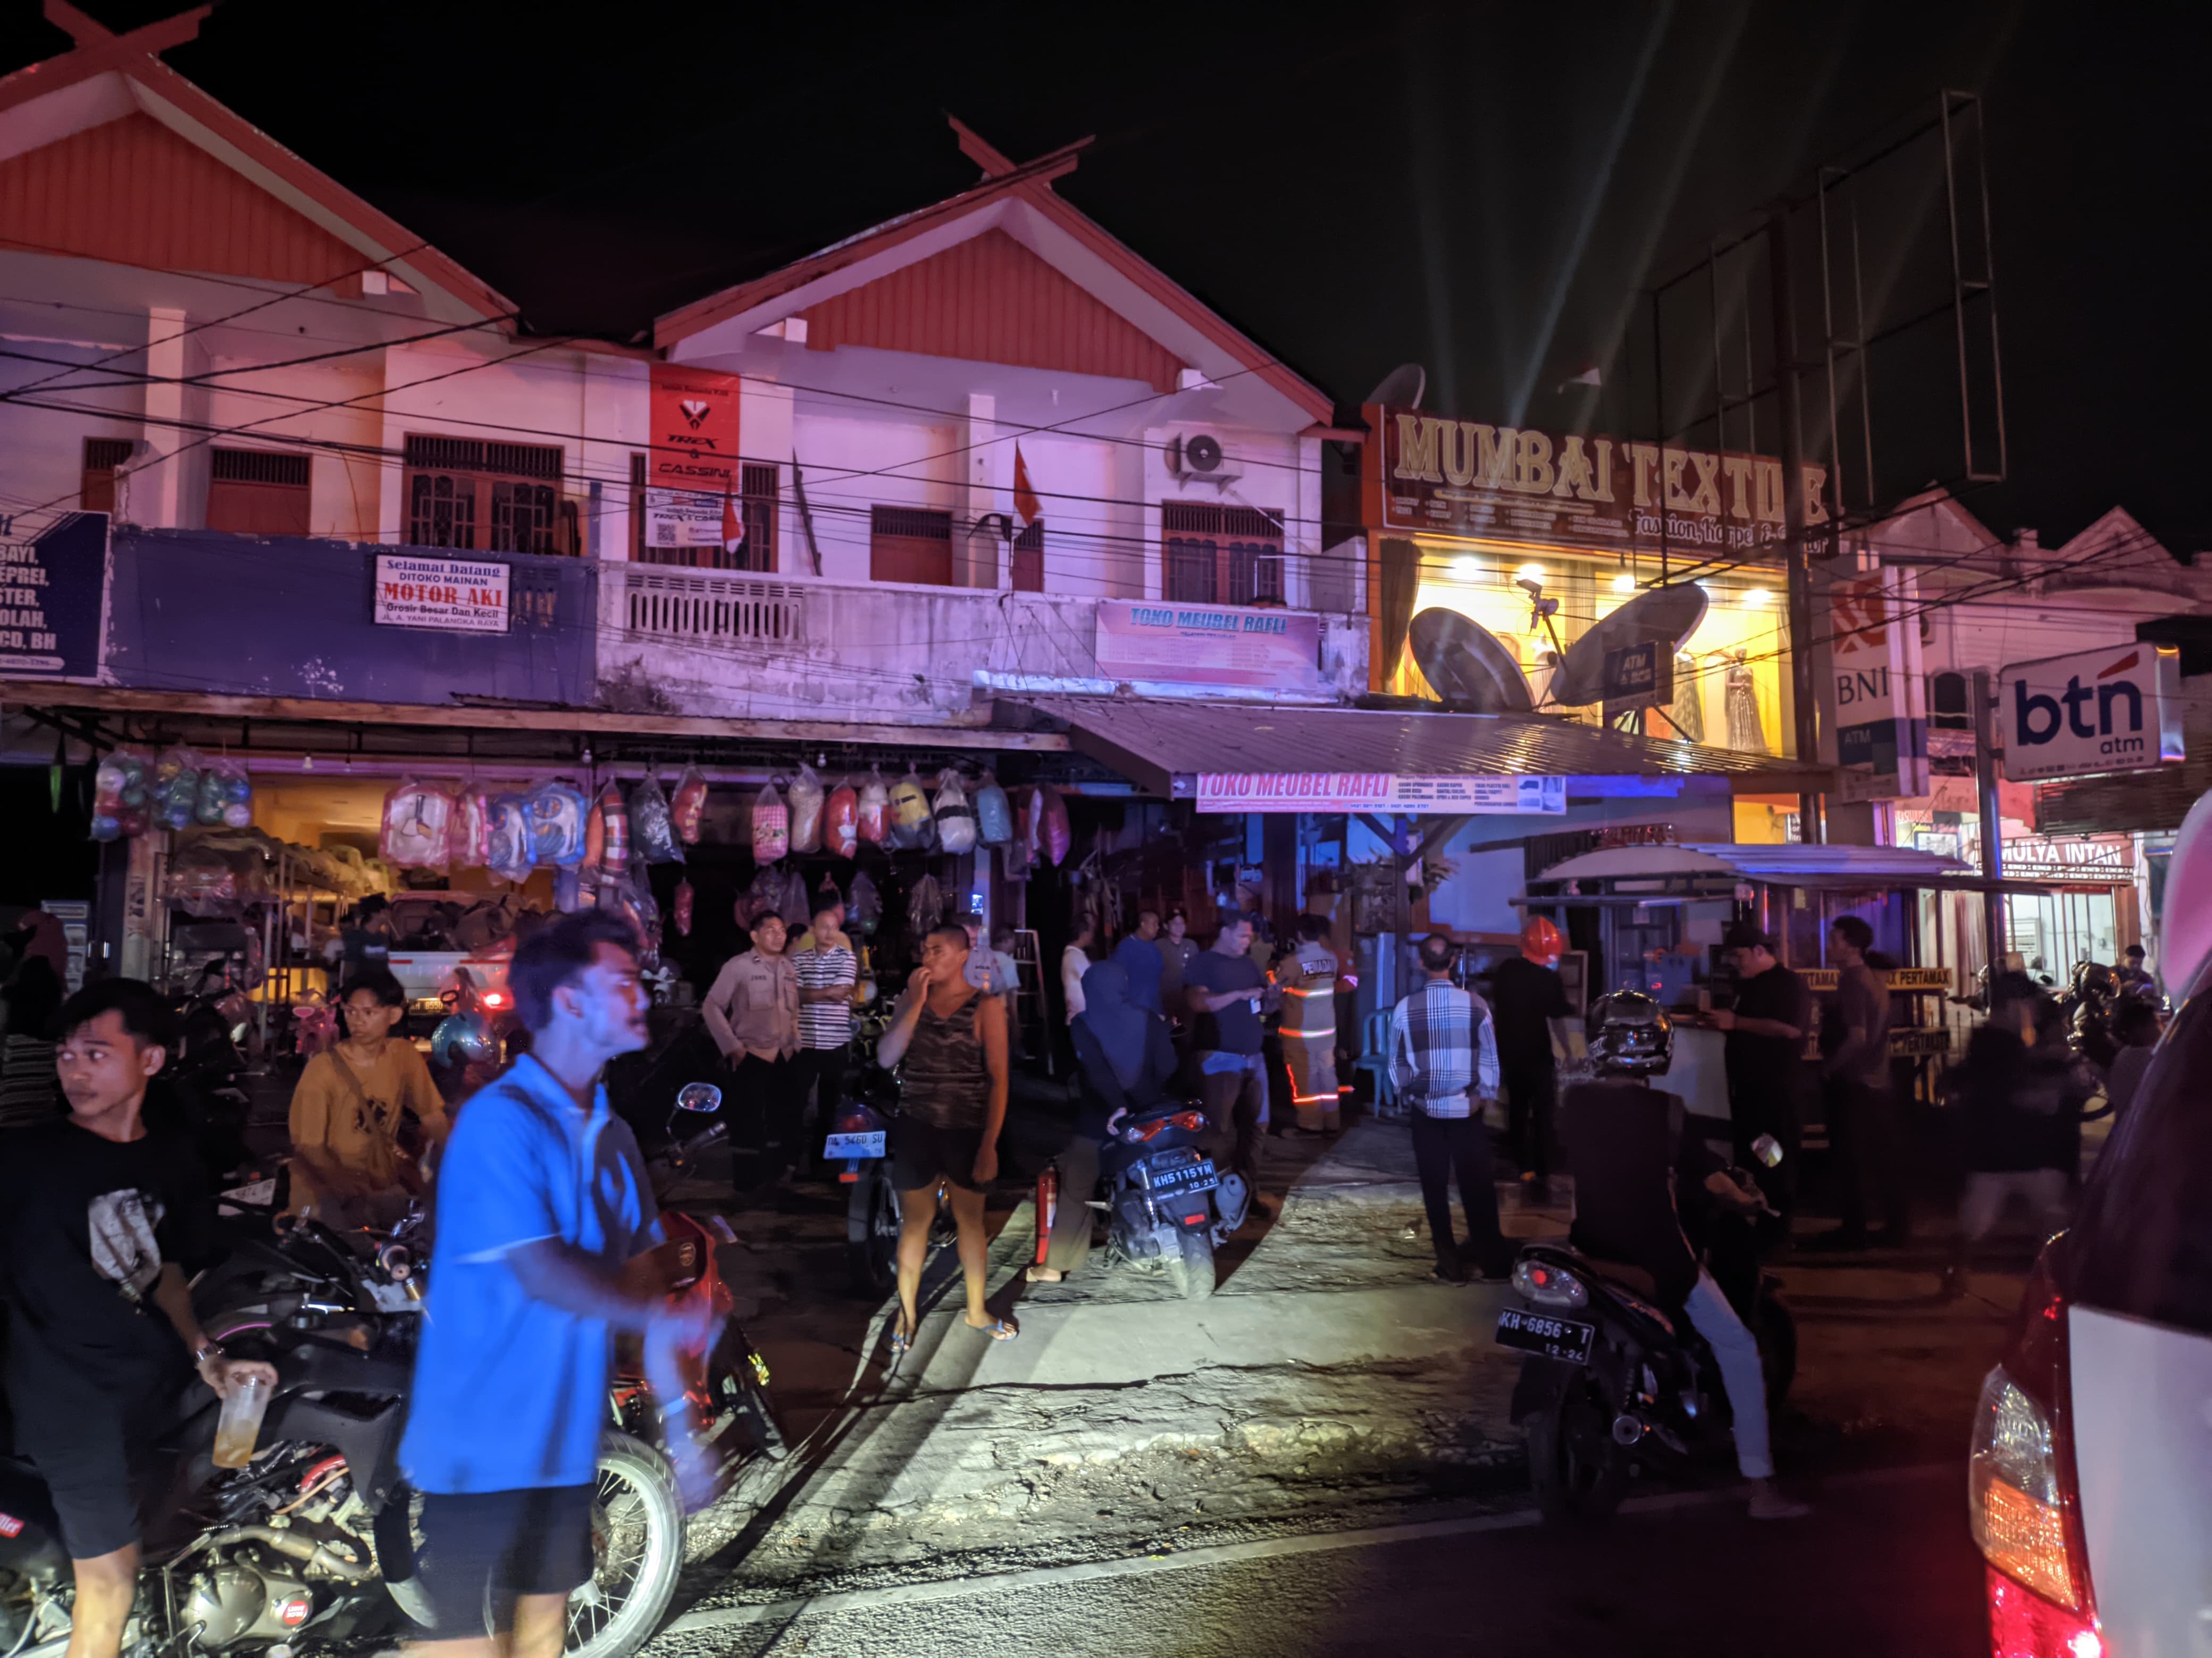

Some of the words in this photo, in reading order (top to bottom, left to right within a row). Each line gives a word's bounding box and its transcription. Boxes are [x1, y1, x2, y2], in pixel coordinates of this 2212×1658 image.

[1394, 414, 1615, 502] MUMBAI
[659, 463, 730, 478] CASSINI
[387, 559, 445, 572] Selamat
[450, 564, 501, 578] Datang
[399, 573, 441, 583] DITOKO
[444, 576, 488, 586] MAINAN
[384, 582, 457, 604] MOTOR
[467, 587, 502, 607] AKI
[387, 603, 418, 612] Grosir
[420, 605, 449, 614] Besar
[452, 607, 470, 616] Dan
[474, 609, 499, 618] Kecil
[429, 616, 475, 626] PALANGKA
[1130, 608, 1174, 627] TOKO
[1176, 611, 1239, 632] MEUBEL
[1243, 616, 1287, 635] RAFLI
[31, 632, 56, 650] BH
[1837, 666, 1888, 705] BNI
[2015, 675, 2143, 747] btn
[1845, 729, 1871, 744] ATM
[2100, 737, 2144, 754] atm
[1200, 773, 1252, 796] TOKO
[1255, 773, 1331, 796] MEUBEL
[1336, 773, 1390, 797] RAFLI
[2002, 840, 2060, 862] MULYA
[2065, 843, 2122, 865] INTAN
[1900, 970, 1949, 985] PERTAMAX
[1498, 1311, 1521, 1329] KH
[1527, 1317, 1563, 1338] 6856
[1580, 1328, 1590, 1344] T
